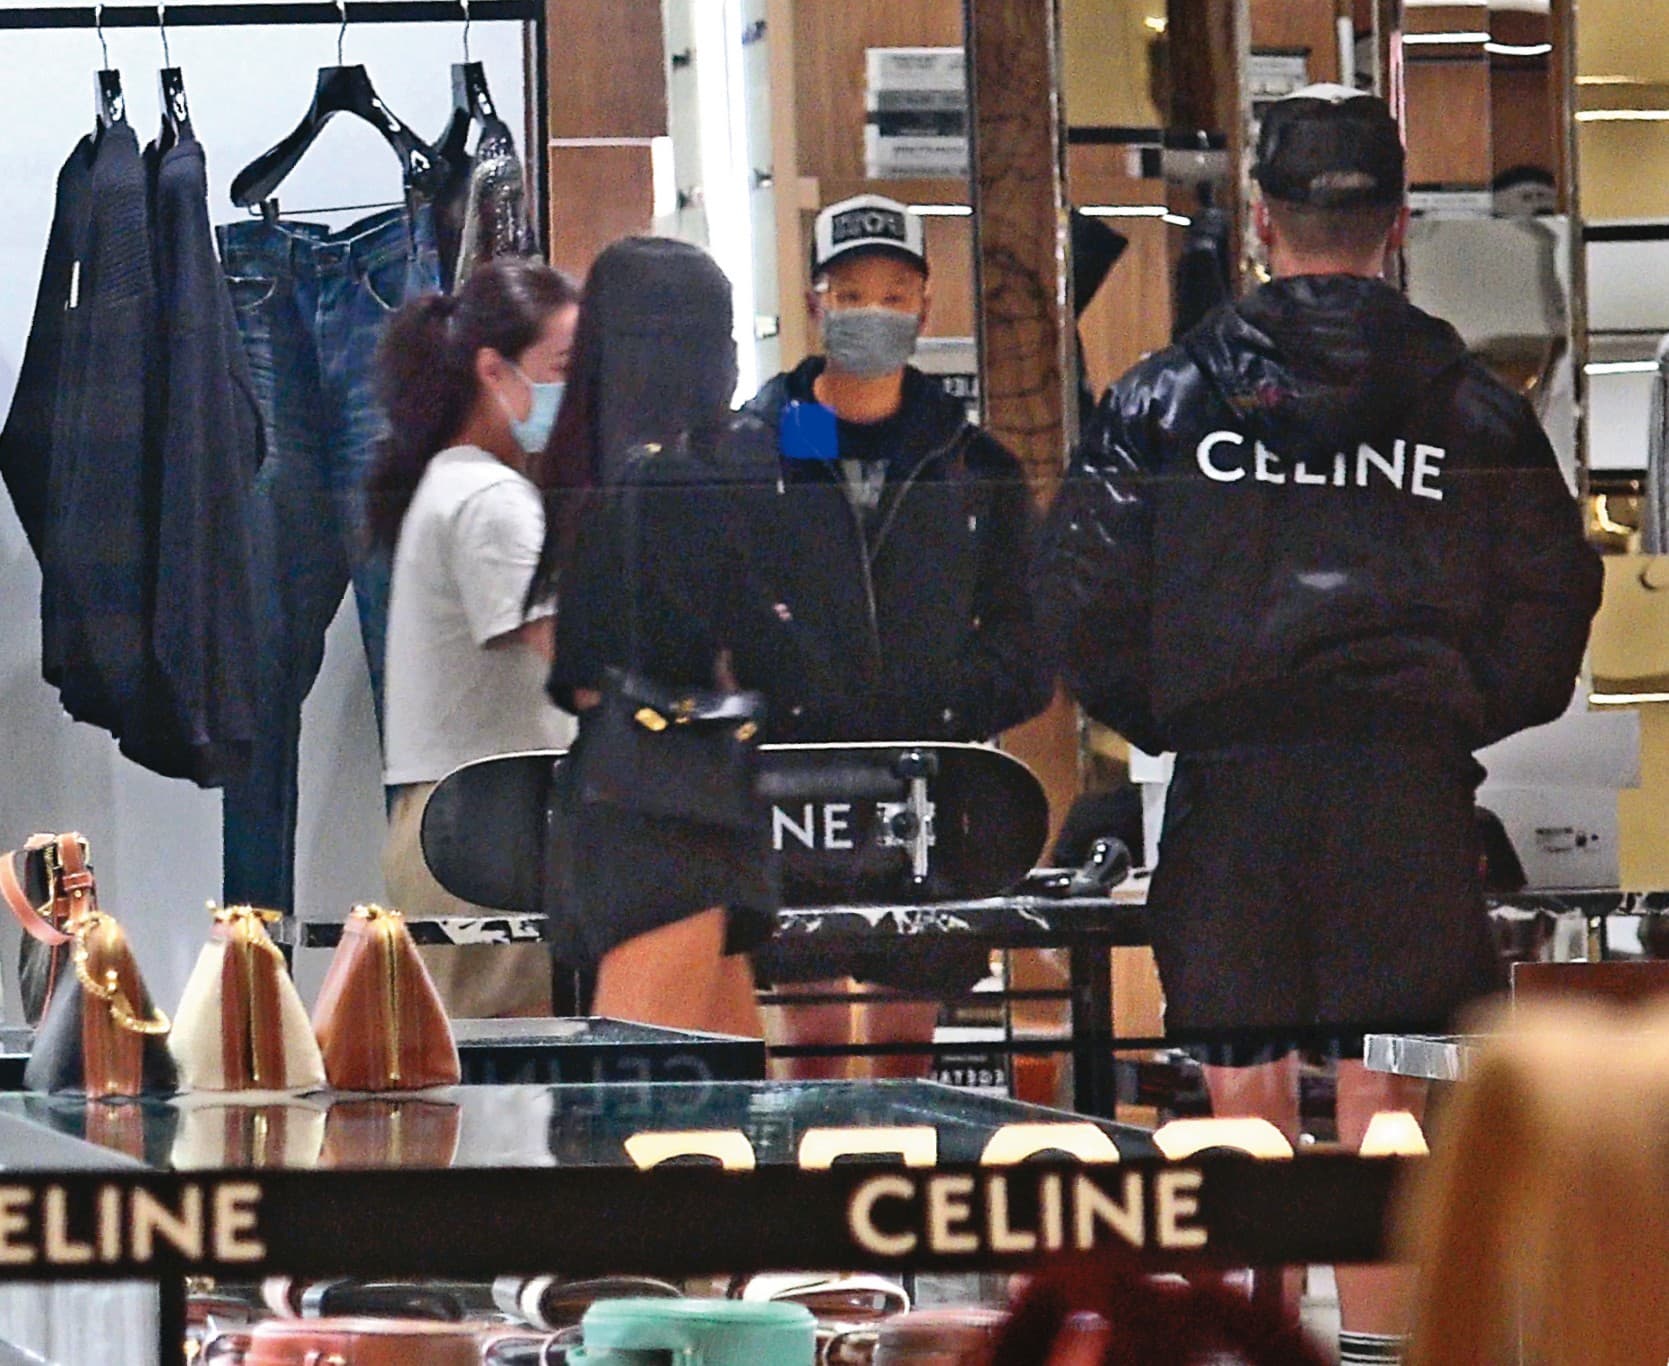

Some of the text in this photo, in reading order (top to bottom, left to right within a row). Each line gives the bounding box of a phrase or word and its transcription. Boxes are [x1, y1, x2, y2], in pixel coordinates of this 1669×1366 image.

[1196, 430, 1446, 501] CELINE
[771, 803, 854, 850] NE
[0, 1181, 267, 1265] ELINE
[847, 1169, 1209, 1257] CELINE
